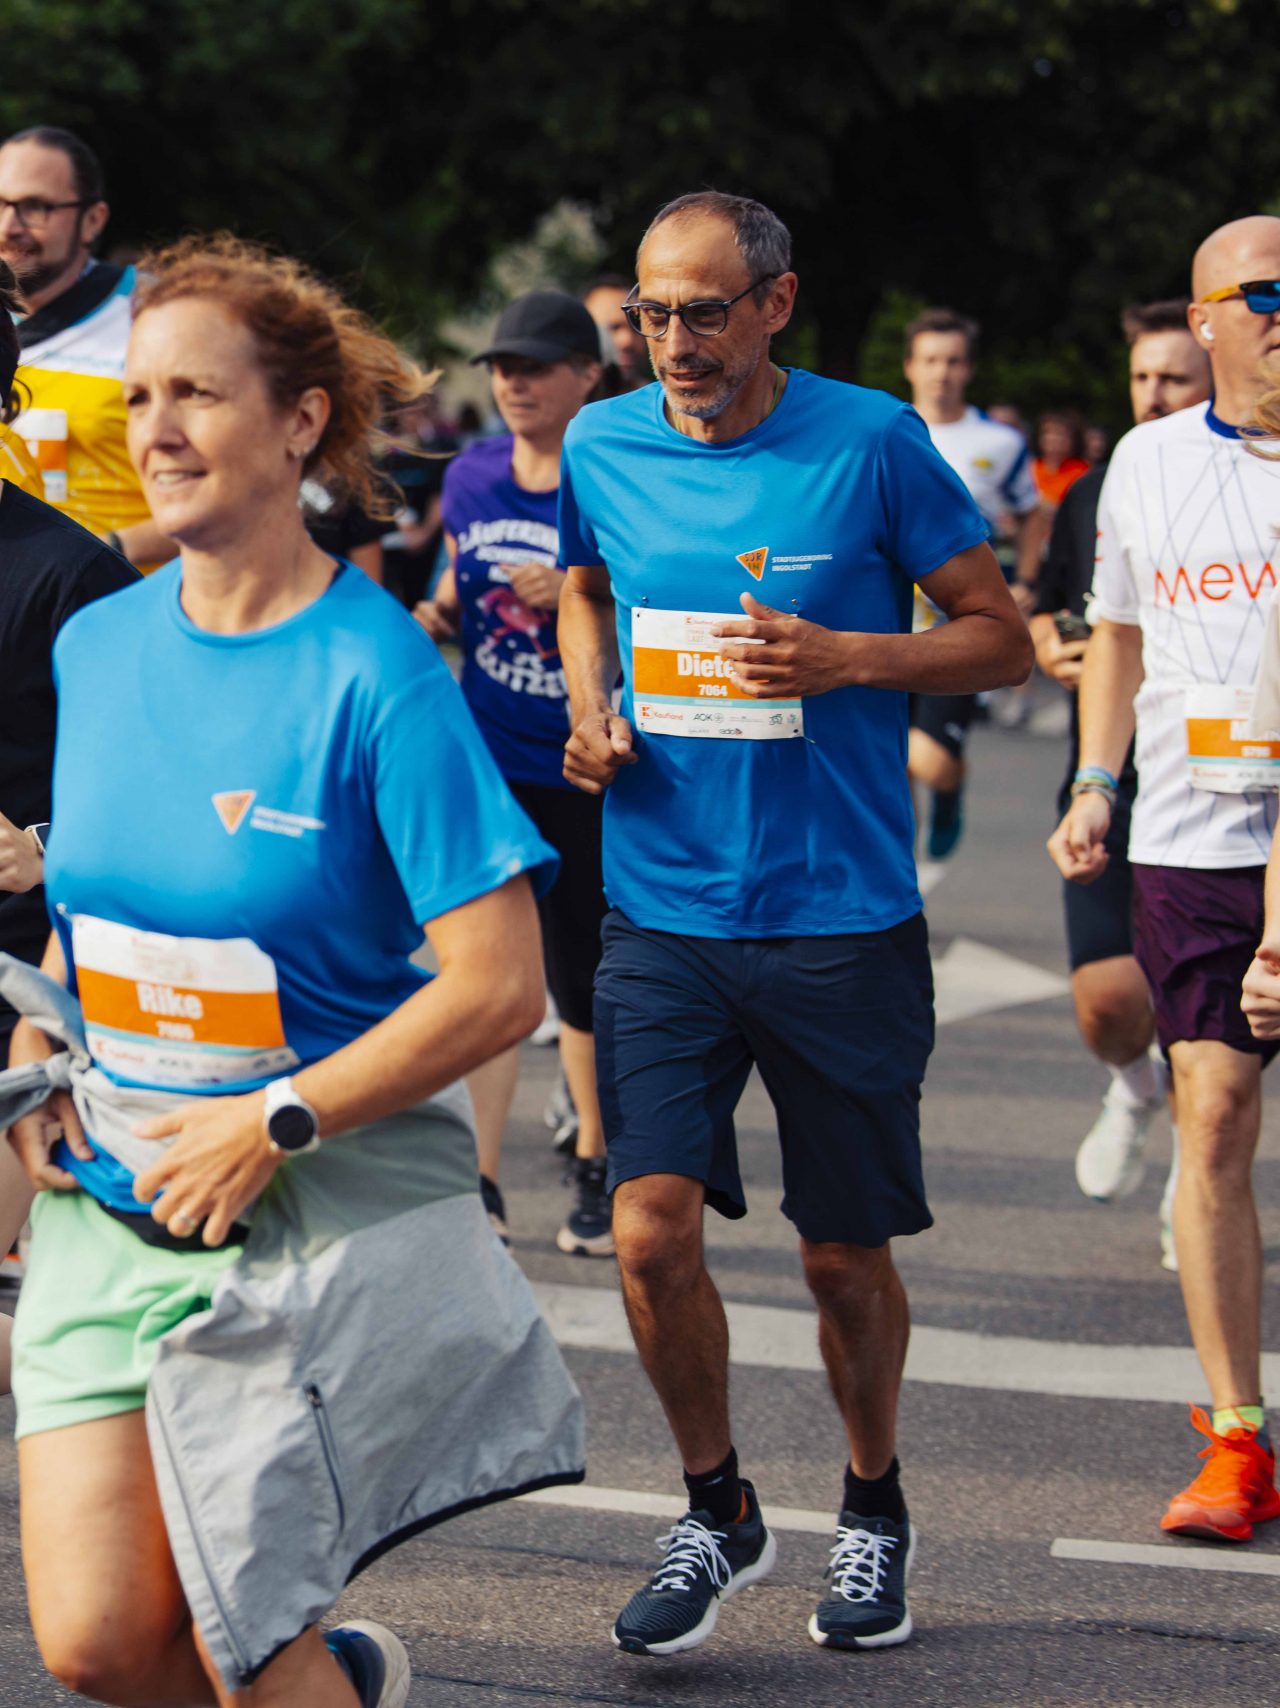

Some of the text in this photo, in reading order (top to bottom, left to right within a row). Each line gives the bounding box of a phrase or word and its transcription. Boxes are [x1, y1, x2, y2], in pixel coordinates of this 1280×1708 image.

[677, 652, 737, 678] Diete
[697, 684, 729, 697] 7064
[693, 713, 713, 722] AOK
[136, 981, 204, 1020] Rike
